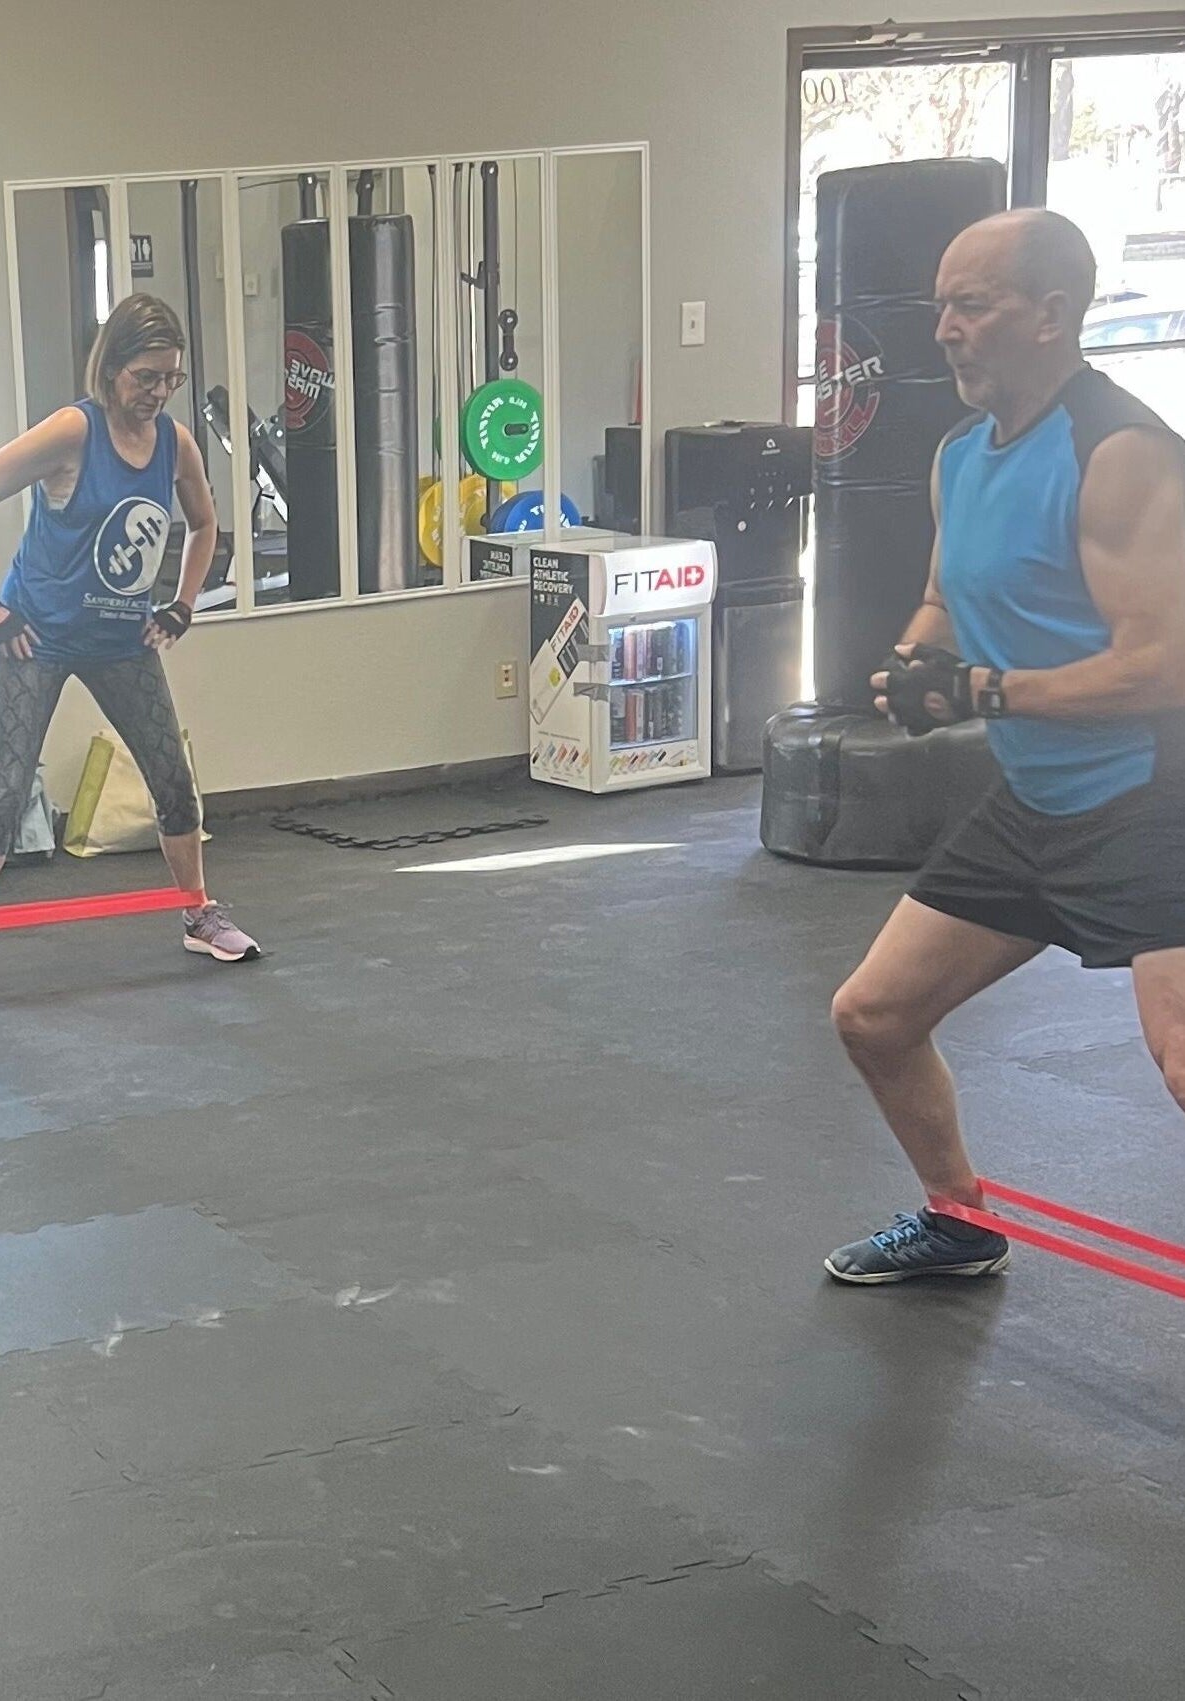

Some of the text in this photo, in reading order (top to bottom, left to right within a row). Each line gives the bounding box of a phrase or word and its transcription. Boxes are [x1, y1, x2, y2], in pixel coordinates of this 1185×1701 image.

[532, 556, 559, 569] CLEAN
[533, 568, 569, 582] ATHLETIC
[614, 564, 705, 596] FITAID
[533, 580, 574, 595] RECOVERY
